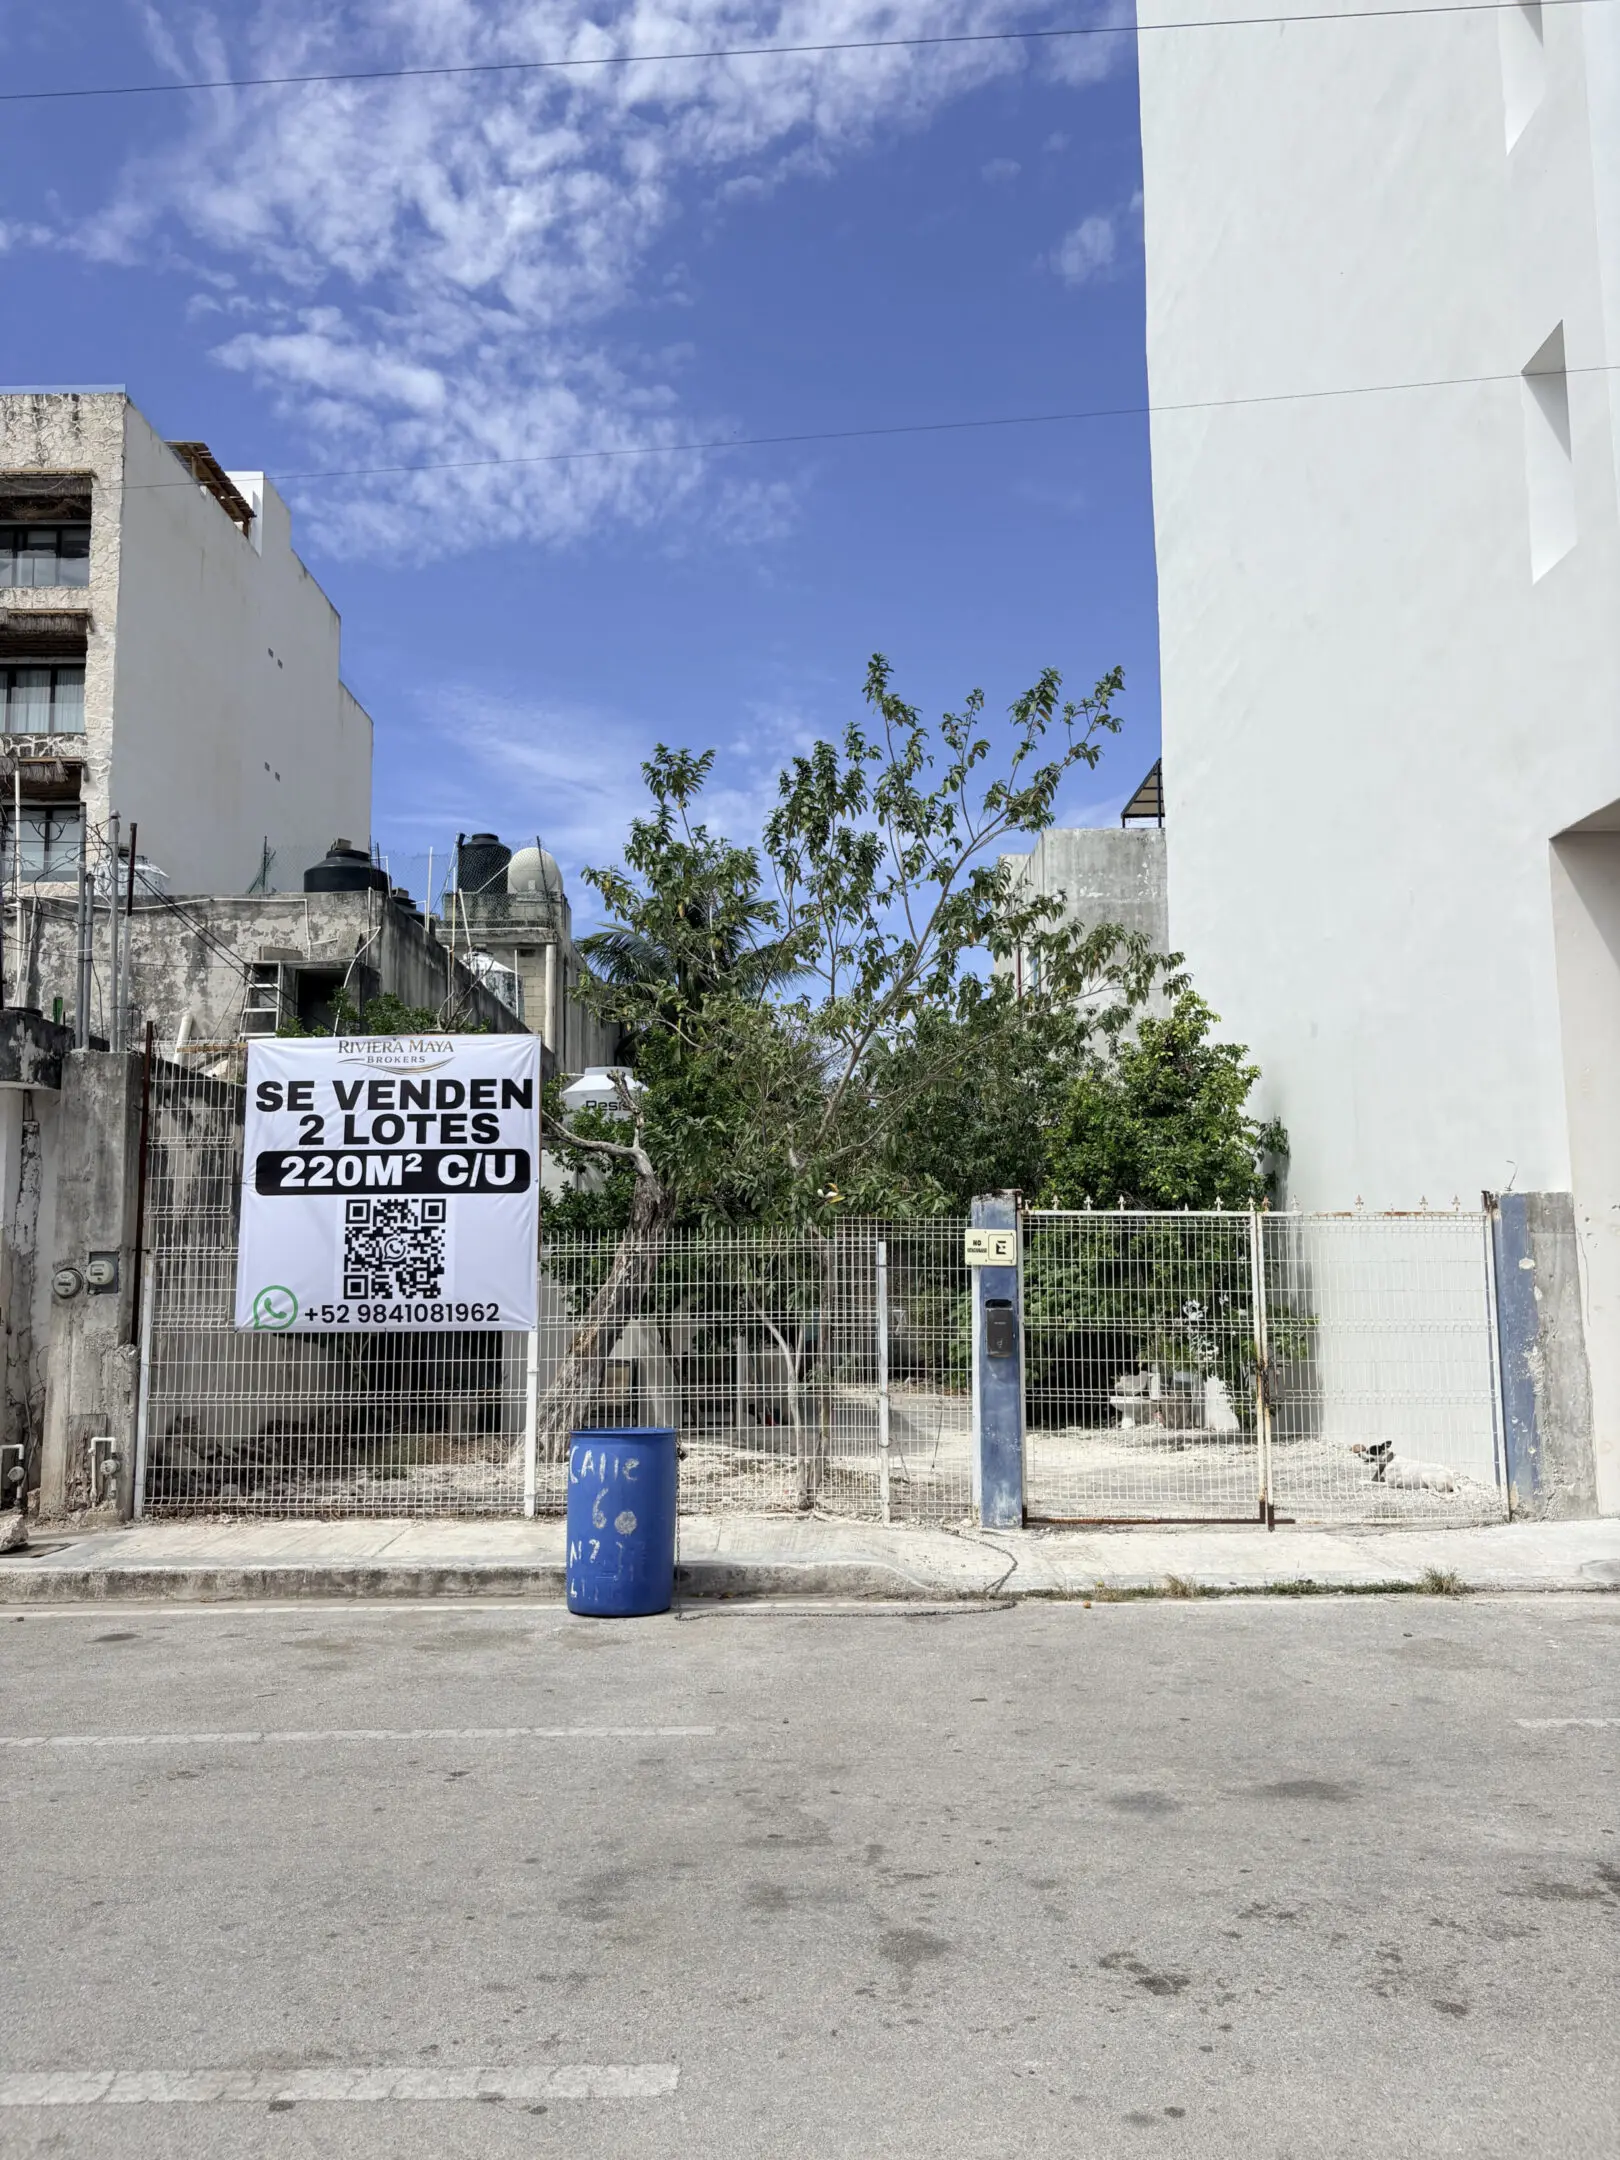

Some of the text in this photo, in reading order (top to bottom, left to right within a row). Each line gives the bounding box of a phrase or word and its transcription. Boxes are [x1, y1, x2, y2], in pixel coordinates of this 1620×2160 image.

[338, 1039, 454, 1054] RIVIERA MAYA
[367, 1056, 426, 1064] BROKERS
[256, 1078, 533, 1112] SE VENDEN
[298, 1113, 500, 1145] 2 LOTES
[437, 1153, 516, 1188] C/U
[305, 1302, 500, 1323] +52 9841081962
